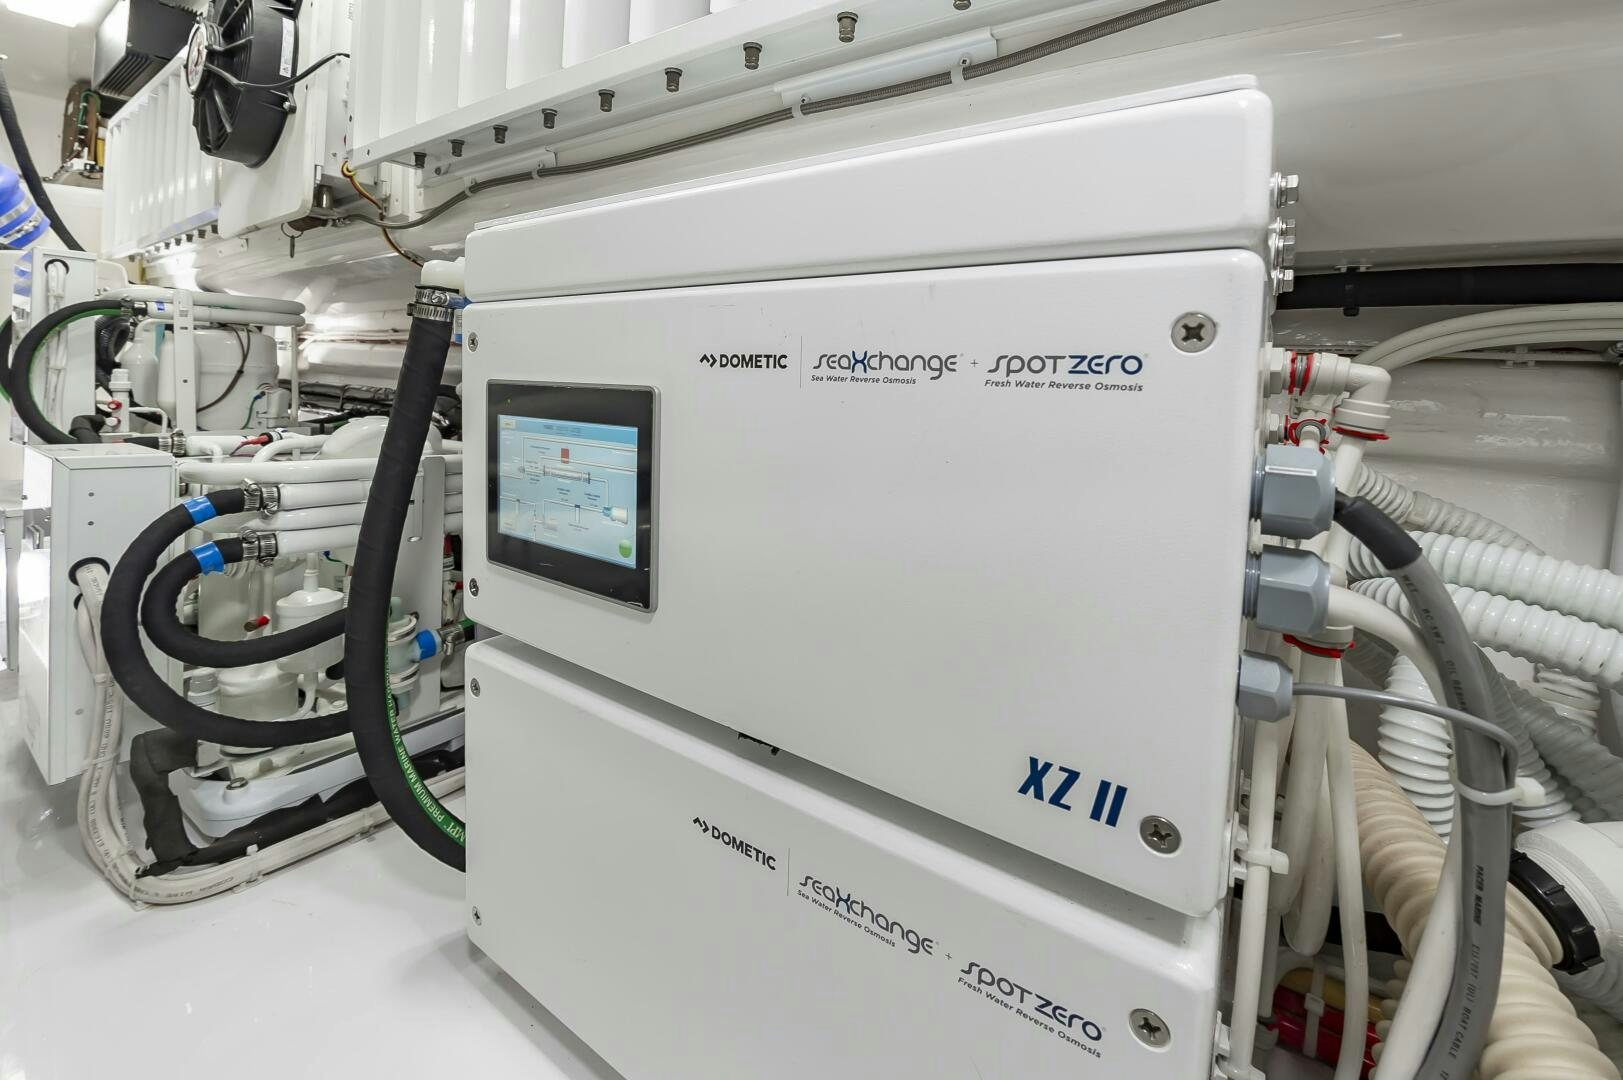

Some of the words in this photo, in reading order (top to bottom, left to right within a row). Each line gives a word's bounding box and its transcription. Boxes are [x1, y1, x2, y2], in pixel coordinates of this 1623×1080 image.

[719, 353, 788, 369] DOMETIC
[811, 374, 824, 382] Sea
[826, 375, 848, 383] Water
[849, 375, 880, 384] Reverse
[882, 376, 917, 385] Osmosis
[984, 379, 1011, 387] Fresh
[1015, 380, 1045, 389] Water
[1048, 381, 1091, 390] Reverse
[1094, 382, 1144, 392] Osmosis
[398, 746, 417, 783] MARINE
[414, 781, 445, 822] PREMIUM
[1017, 756, 1081, 812] XZ
[1089, 779, 1128, 827] II
[711, 825, 776, 871] DOMETIC
[797, 889, 810, 900] Sea
[812, 897, 832, 913] Water
[833, 910, 862, 929] Reverse
[863, 926, 896, 947] Osmosis
[957, 977, 983, 994] Fresh
[985, 991, 1014, 1011] Water
[1016, 1008, 1055, 1033] Reverse
[1057, 1030, 1101, 1058] Osmosis
